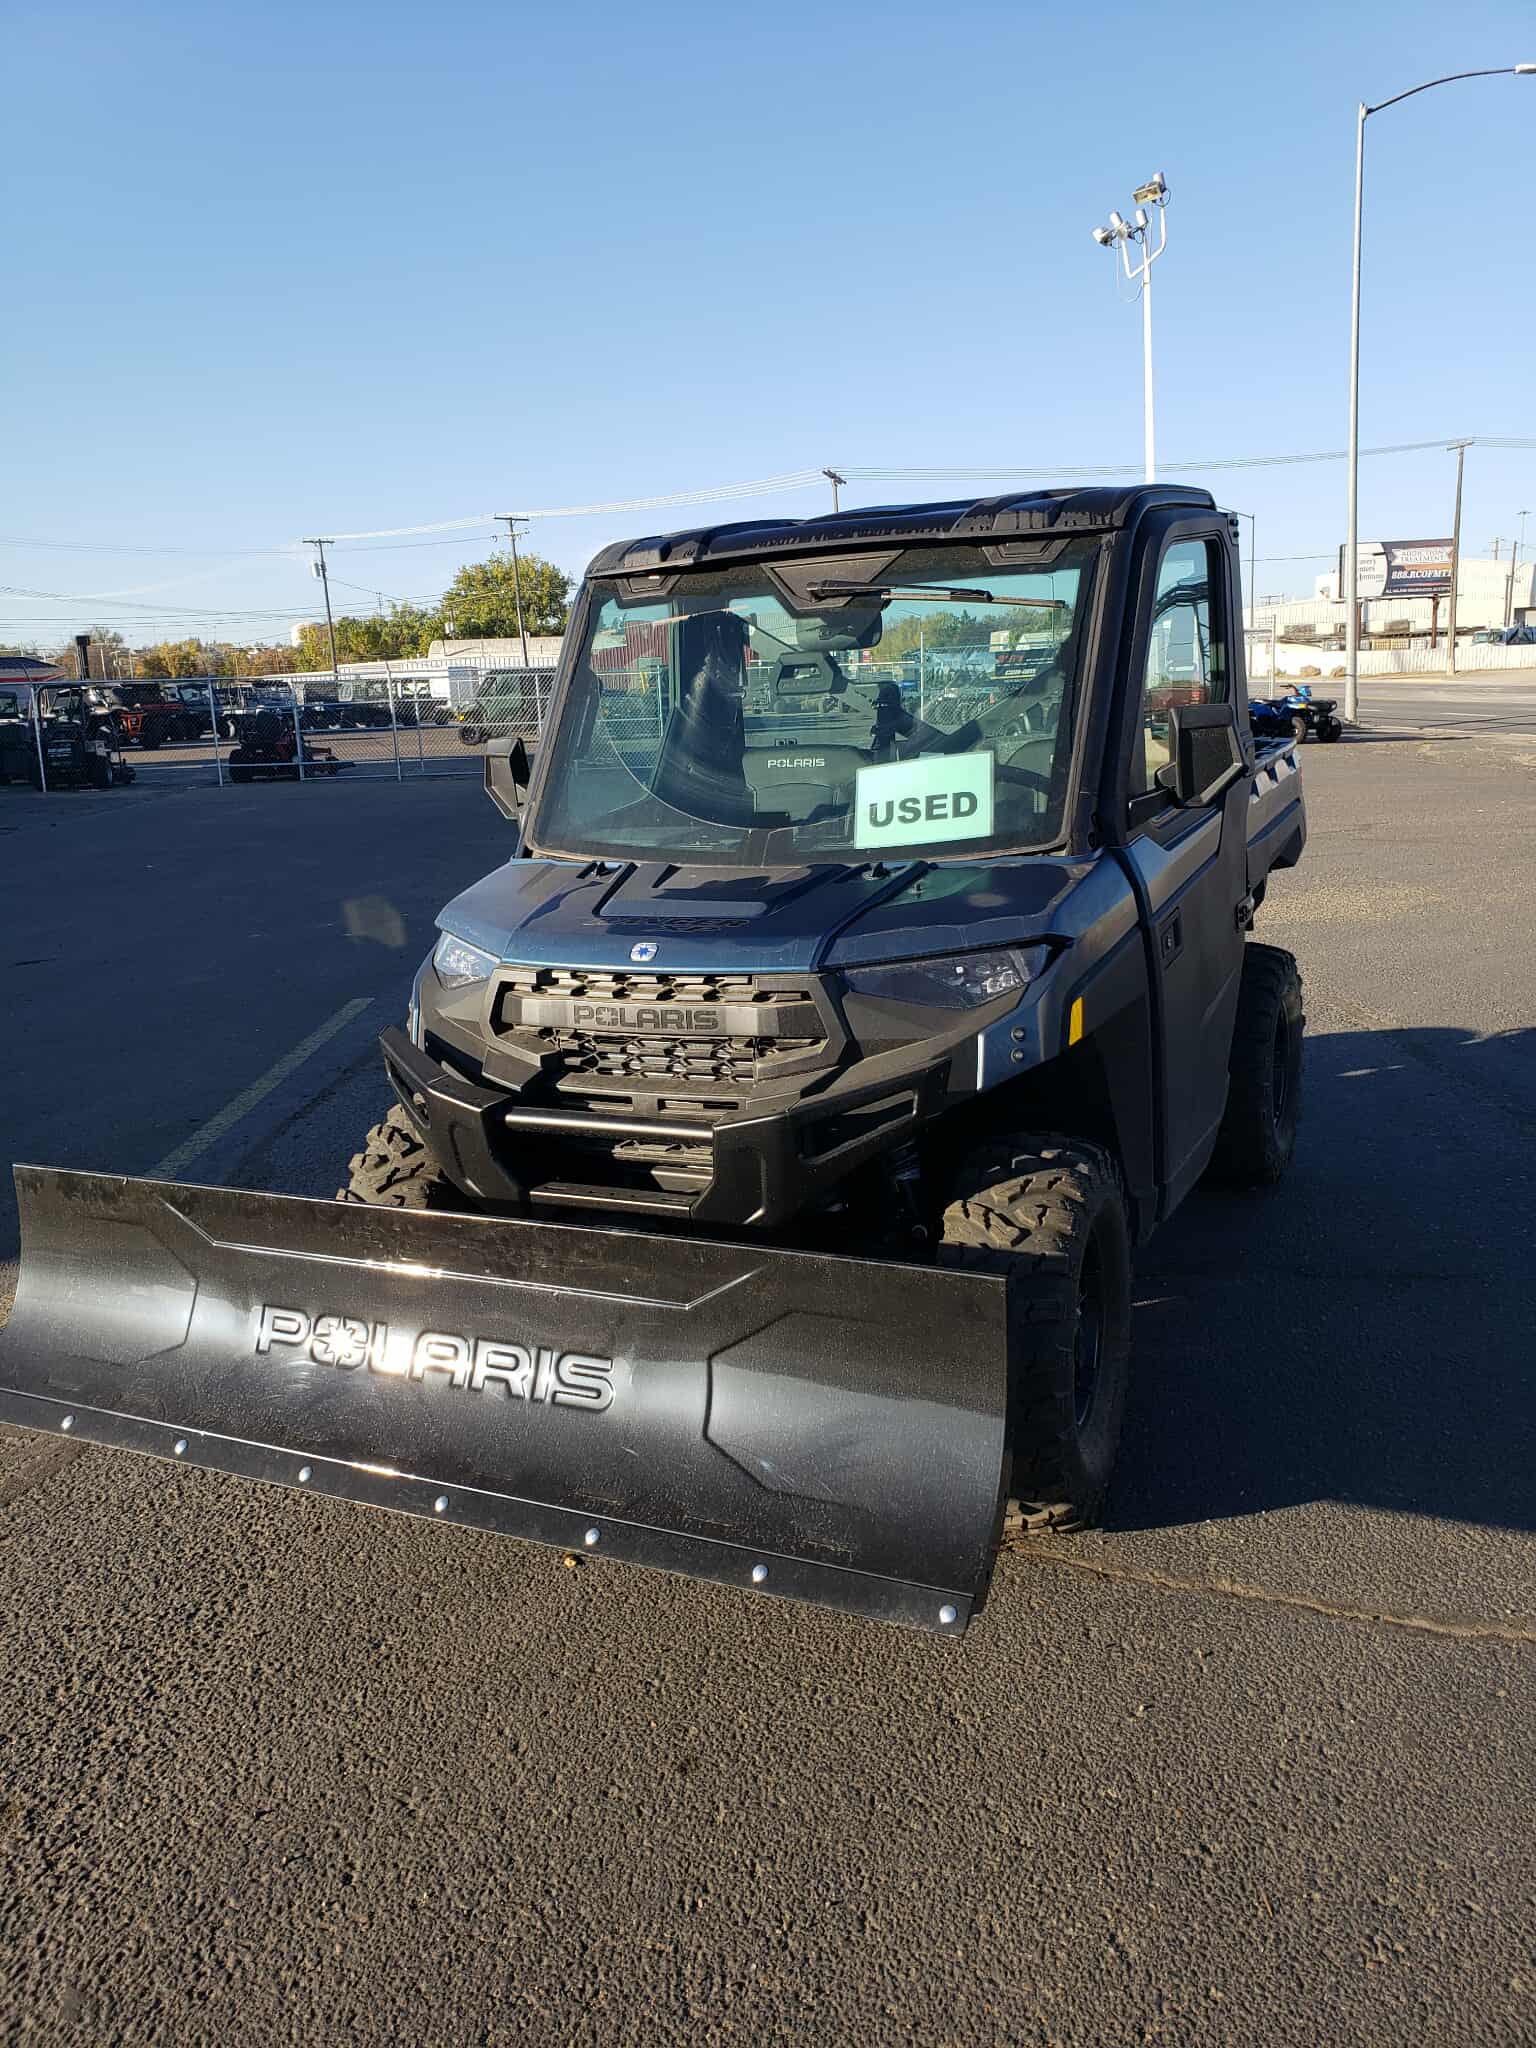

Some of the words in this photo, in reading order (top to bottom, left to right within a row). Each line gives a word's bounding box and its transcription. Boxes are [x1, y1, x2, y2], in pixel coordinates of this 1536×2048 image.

[767, 757, 825, 769] POLARIS
[868, 791, 978, 828] USED
[573, 1004, 720, 1031] POLARIS
[254, 1303, 616, 1414] POLARIS
